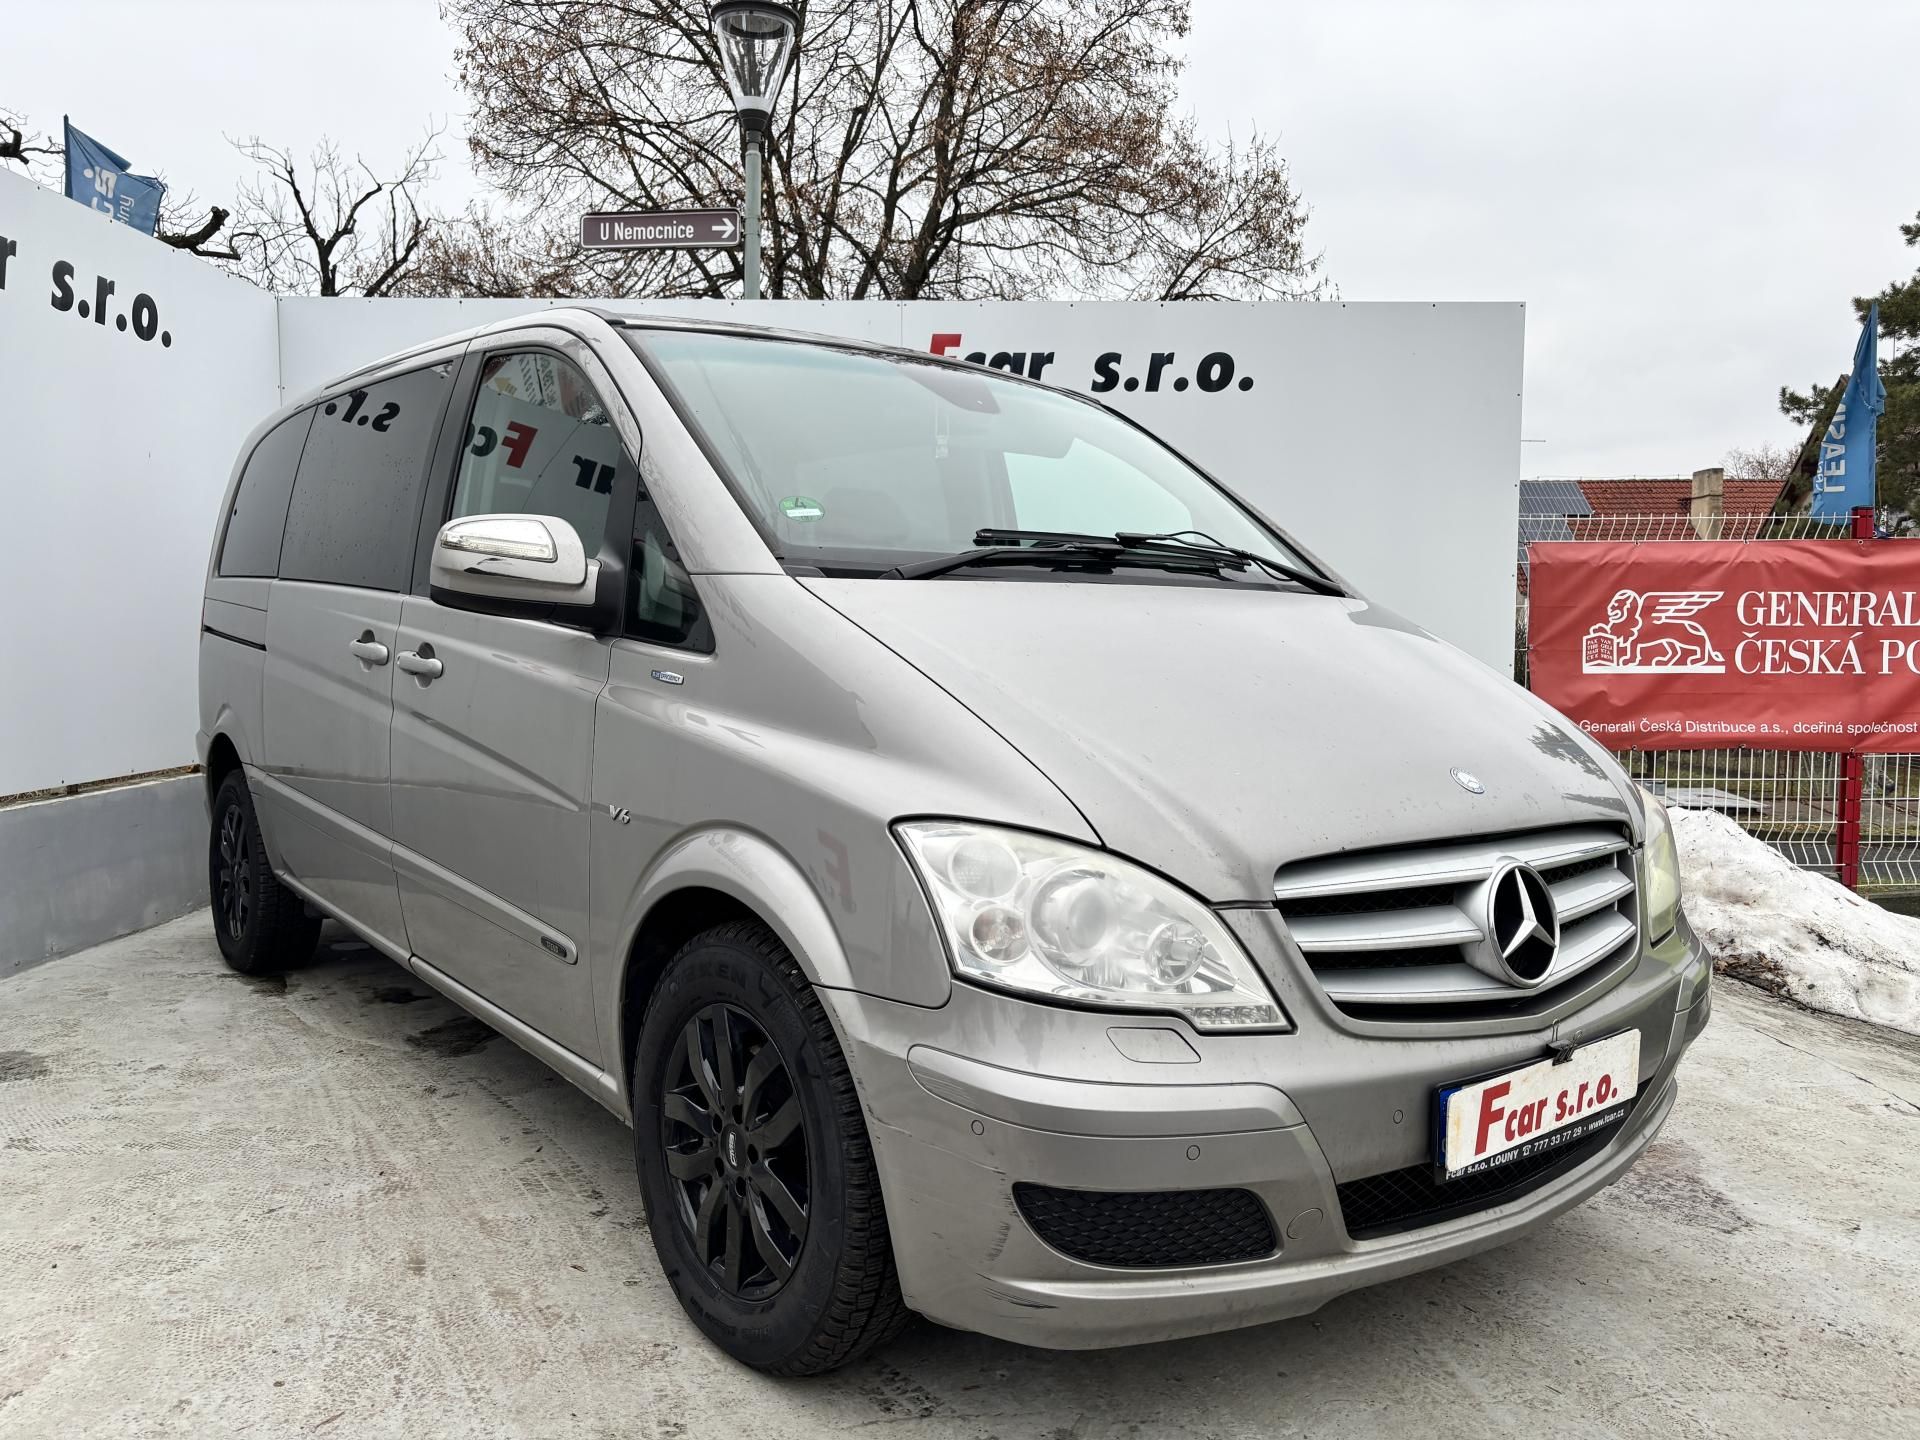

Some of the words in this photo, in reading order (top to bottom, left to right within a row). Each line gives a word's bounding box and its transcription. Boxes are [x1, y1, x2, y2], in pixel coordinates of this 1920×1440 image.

[600, 222, 610, 242] U
[614, 220, 695, 241] Nemocnice
[51, 260, 172, 348] s.r.o.
[1091, 352, 1254, 393] s.r.o.
[1736, 590, 1920, 627] GENERAL
[1734, 631, 1866, 675] ČESKÁ
[1579, 719, 1636, 733] Generali
[1640, 717, 1682, 733] Česká
[1686, 719, 1756, 733] Distribuce
[1760, 723, 1789, 735] a.s.,
[1793, 721, 1843, 734] dceřiná
[1847, 721, 1918, 736] společnost
[1474, 1080, 1548, 1156] Fcar
[1555, 1073, 1618, 1122] s.r.o.
[1467, 1162, 1488, 1174] s.r.o.
[1490, 1149, 1520, 1167] LOUNY
[1533, 1138, 1549, 1152] 777
[1550, 1134, 1561, 1146] 33
[1562, 1130, 1573, 1143] 77
[1573, 1126, 1582, 1140] 29
